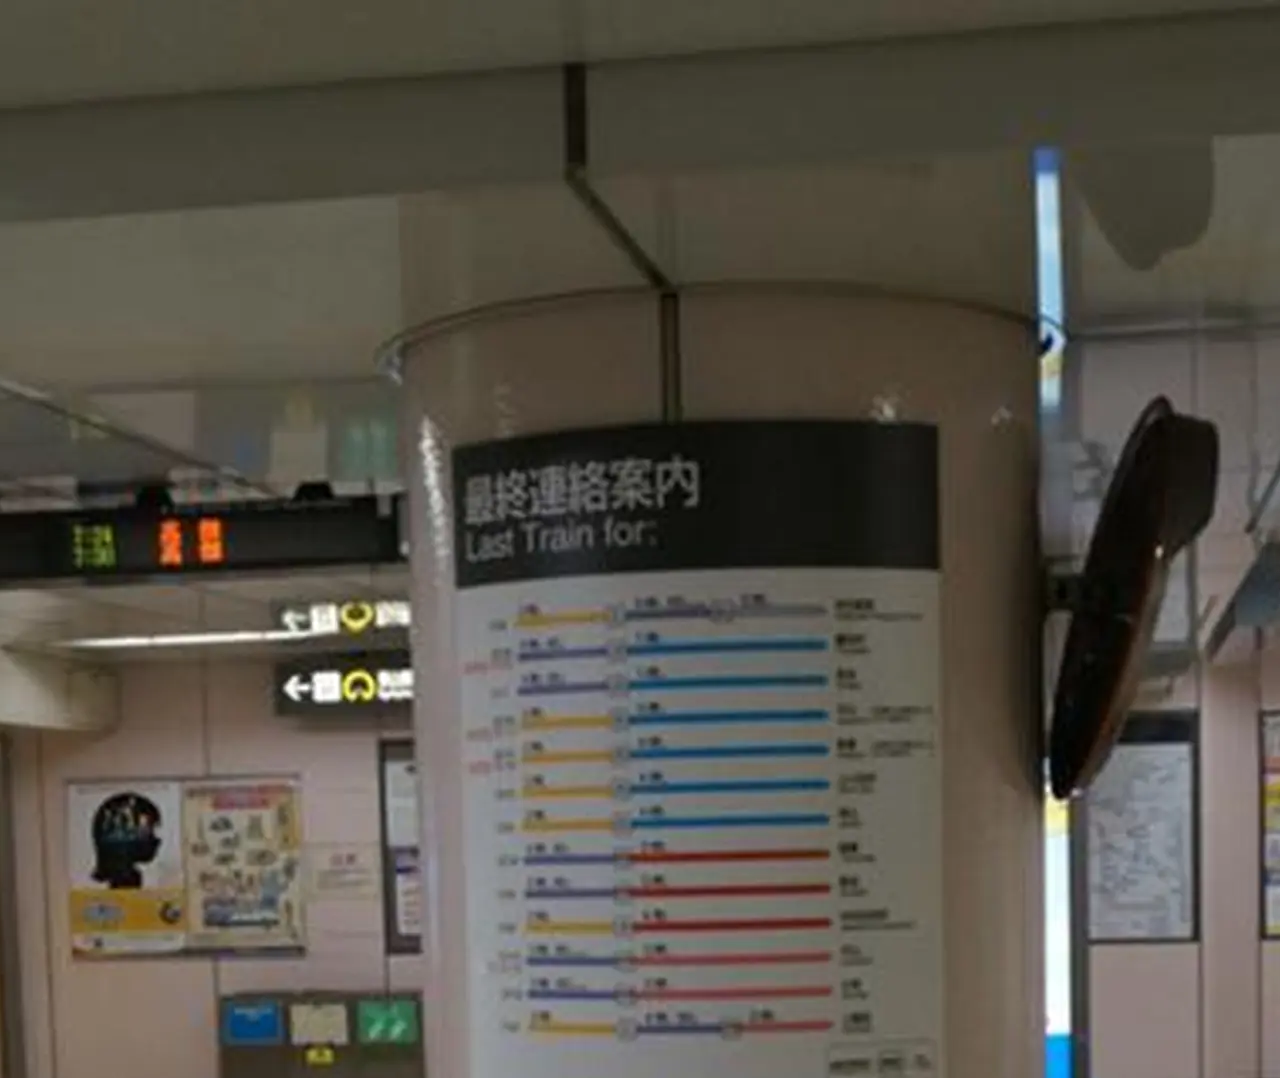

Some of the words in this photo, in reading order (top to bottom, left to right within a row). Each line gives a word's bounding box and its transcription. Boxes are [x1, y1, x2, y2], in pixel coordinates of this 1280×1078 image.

[465, 454, 700, 527] 最終連絡案内
[465, 528, 515, 562] Last
[522, 518, 594, 553] Train
[604, 515, 657, 548] for:
